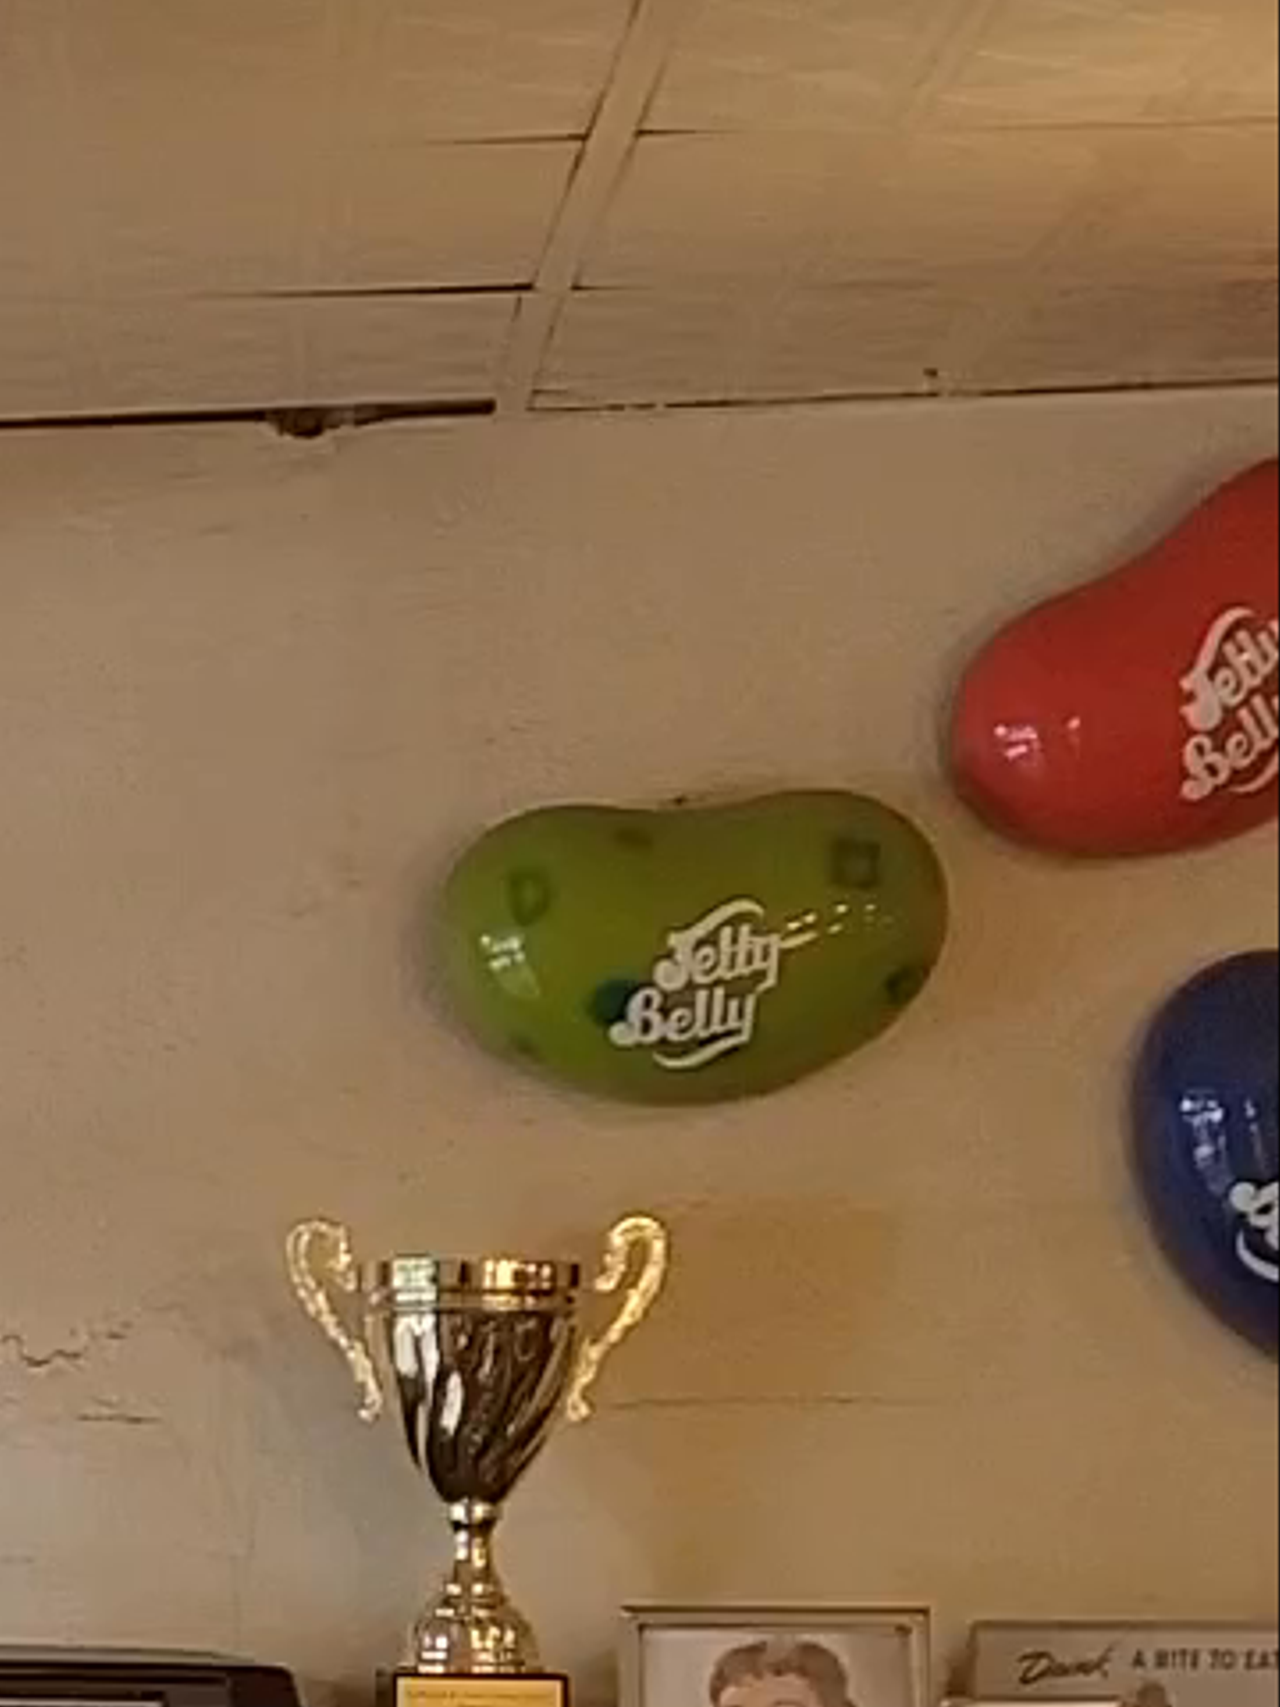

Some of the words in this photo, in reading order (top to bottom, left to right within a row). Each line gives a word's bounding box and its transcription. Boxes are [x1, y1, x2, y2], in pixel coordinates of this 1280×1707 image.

[1183, 695, 1278, 799] Bell
[653, 900, 783, 993] Jelly
[609, 985, 756, 1070] Belly
[1131, 1650, 1146, 1670] A
[1208, 1649, 1237, 1670] TO
